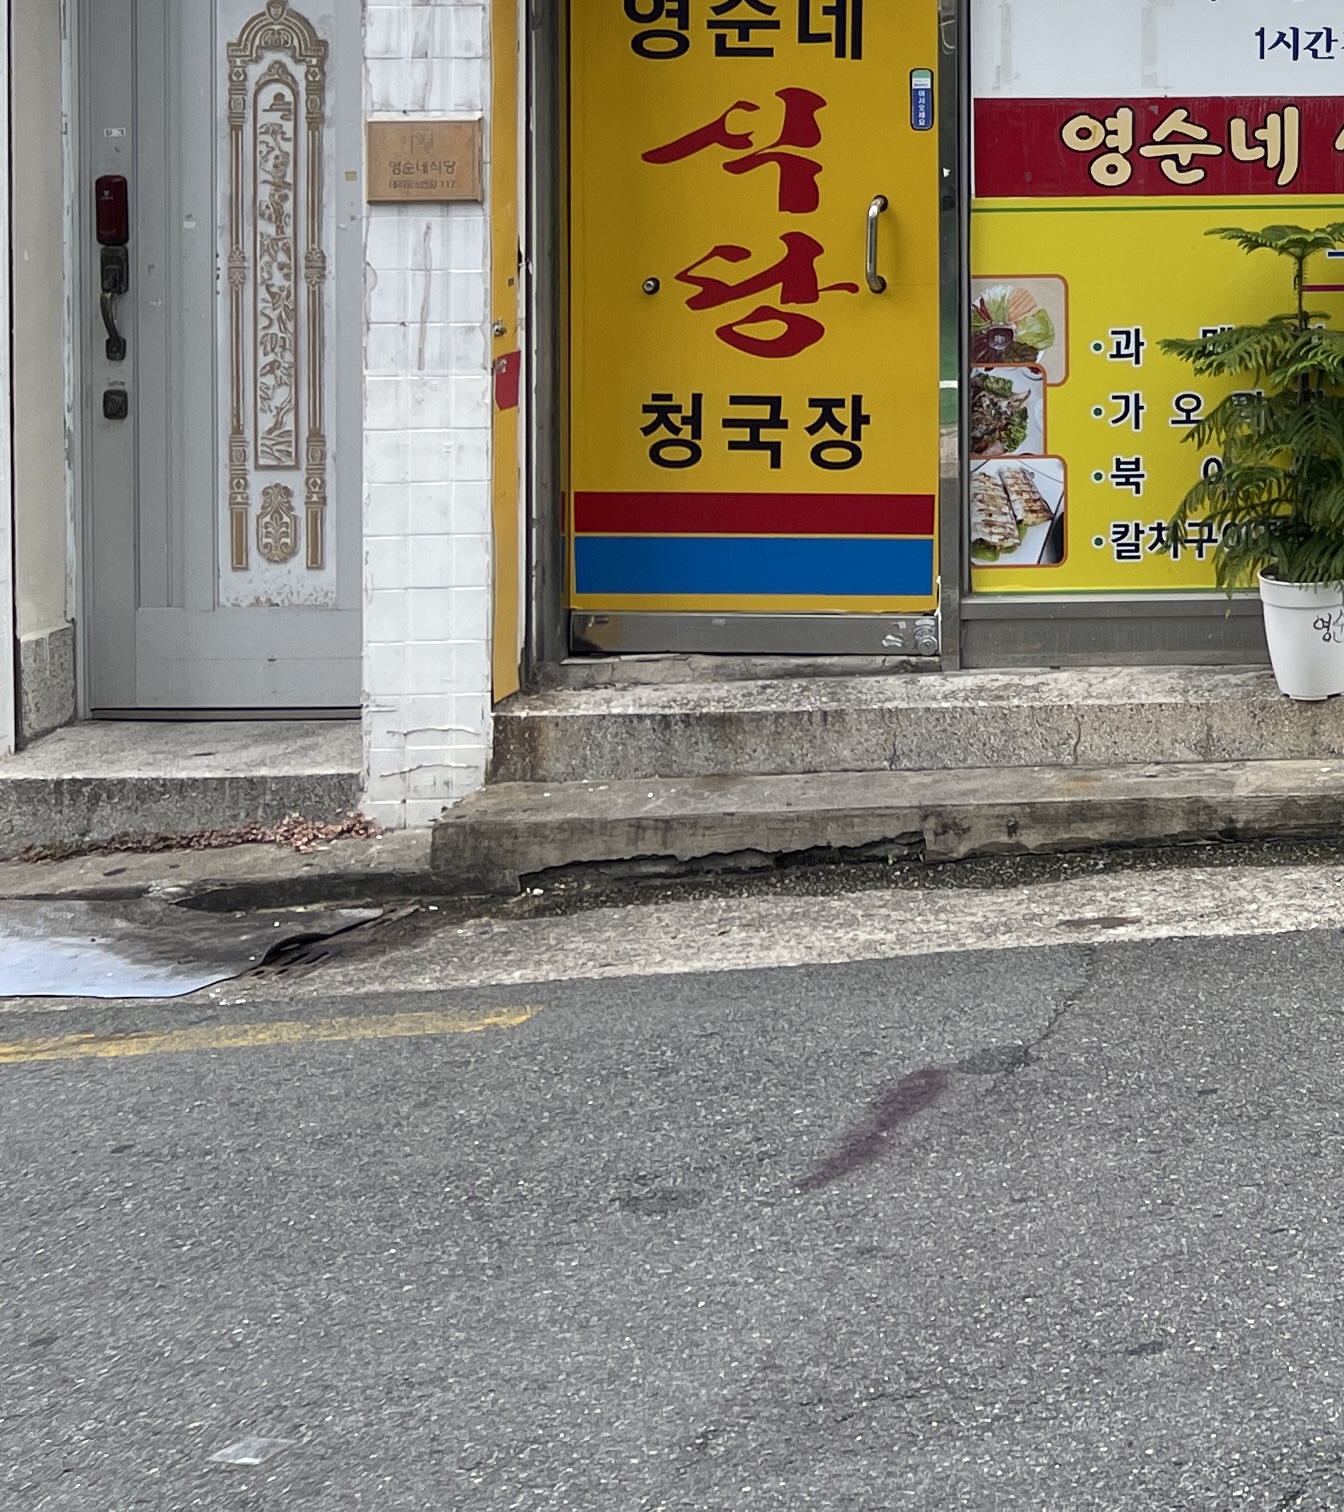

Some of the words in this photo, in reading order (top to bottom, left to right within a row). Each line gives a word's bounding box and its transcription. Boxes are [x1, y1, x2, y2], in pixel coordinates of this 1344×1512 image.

[388, 160, 457, 176] 영순네식당
[1061, 104, 1301, 187] 영순네
[640, 391, 872, 470] 청국장
